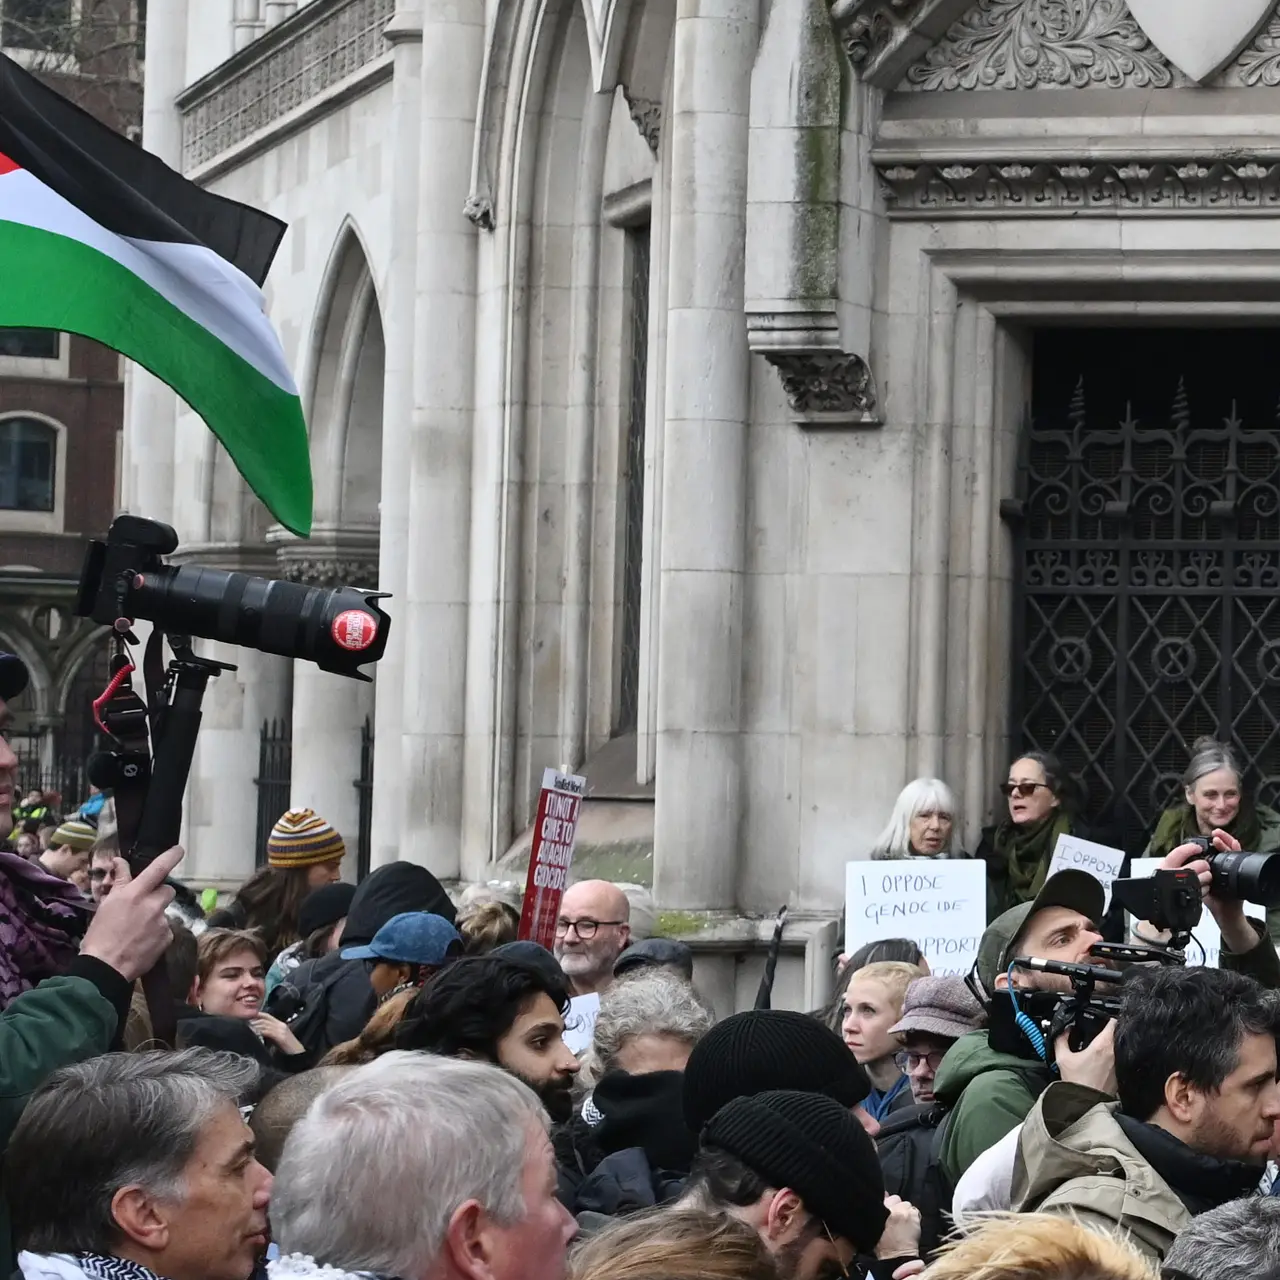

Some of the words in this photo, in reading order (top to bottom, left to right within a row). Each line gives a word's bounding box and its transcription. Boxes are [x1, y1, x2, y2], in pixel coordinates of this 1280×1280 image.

[1056, 844, 1073, 861] I
[1073, 851, 1119, 877] OPPOSE
[861, 875, 867, 896] I
[882, 874, 946, 894] OPPOSE
[864, 898, 969, 925] GENOCIDE
[917, 936, 981, 957] PPORT
